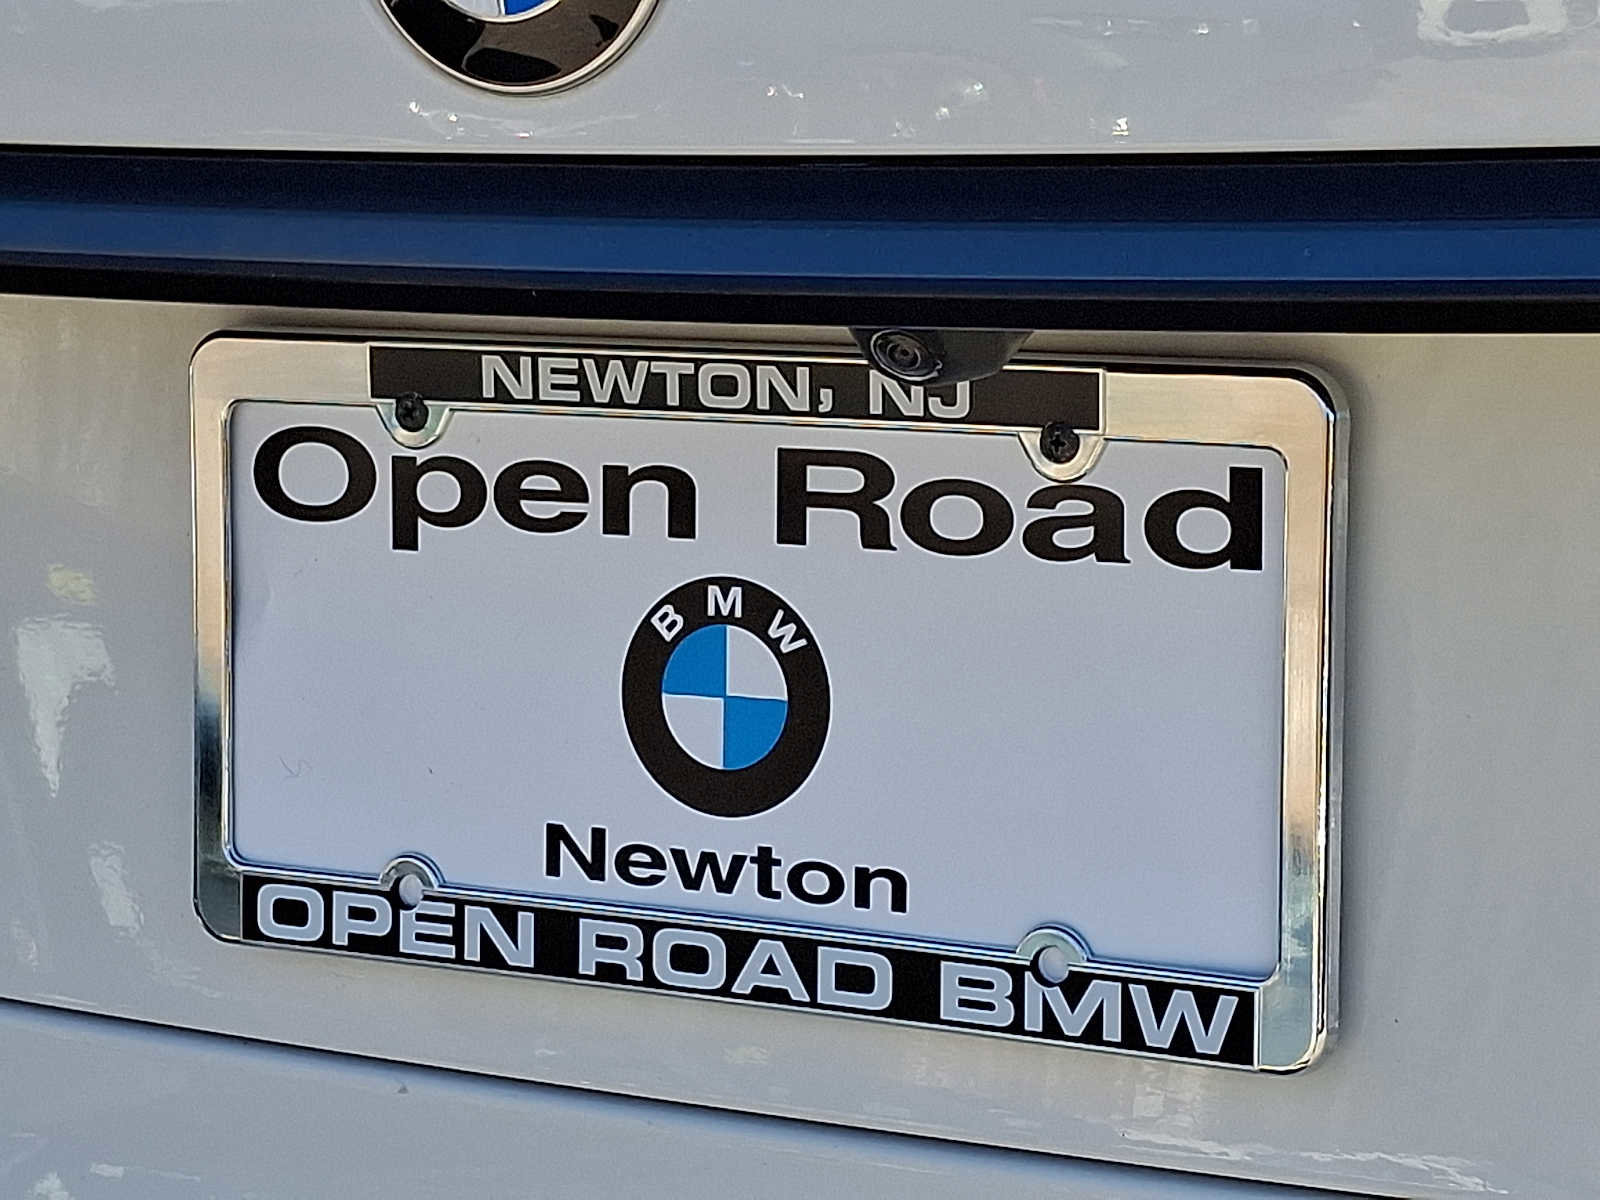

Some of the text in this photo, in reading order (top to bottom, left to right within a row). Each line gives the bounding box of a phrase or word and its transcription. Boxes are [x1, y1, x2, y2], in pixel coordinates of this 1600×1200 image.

[480, 353, 973, 420] NEWTON, NJ
[254, 426, 1263, 571] Open Road
[650, 584, 808, 654] BMW
[545, 822, 908, 913] Newton
[256, 883, 1239, 1056] OPEN ROAD BMW
